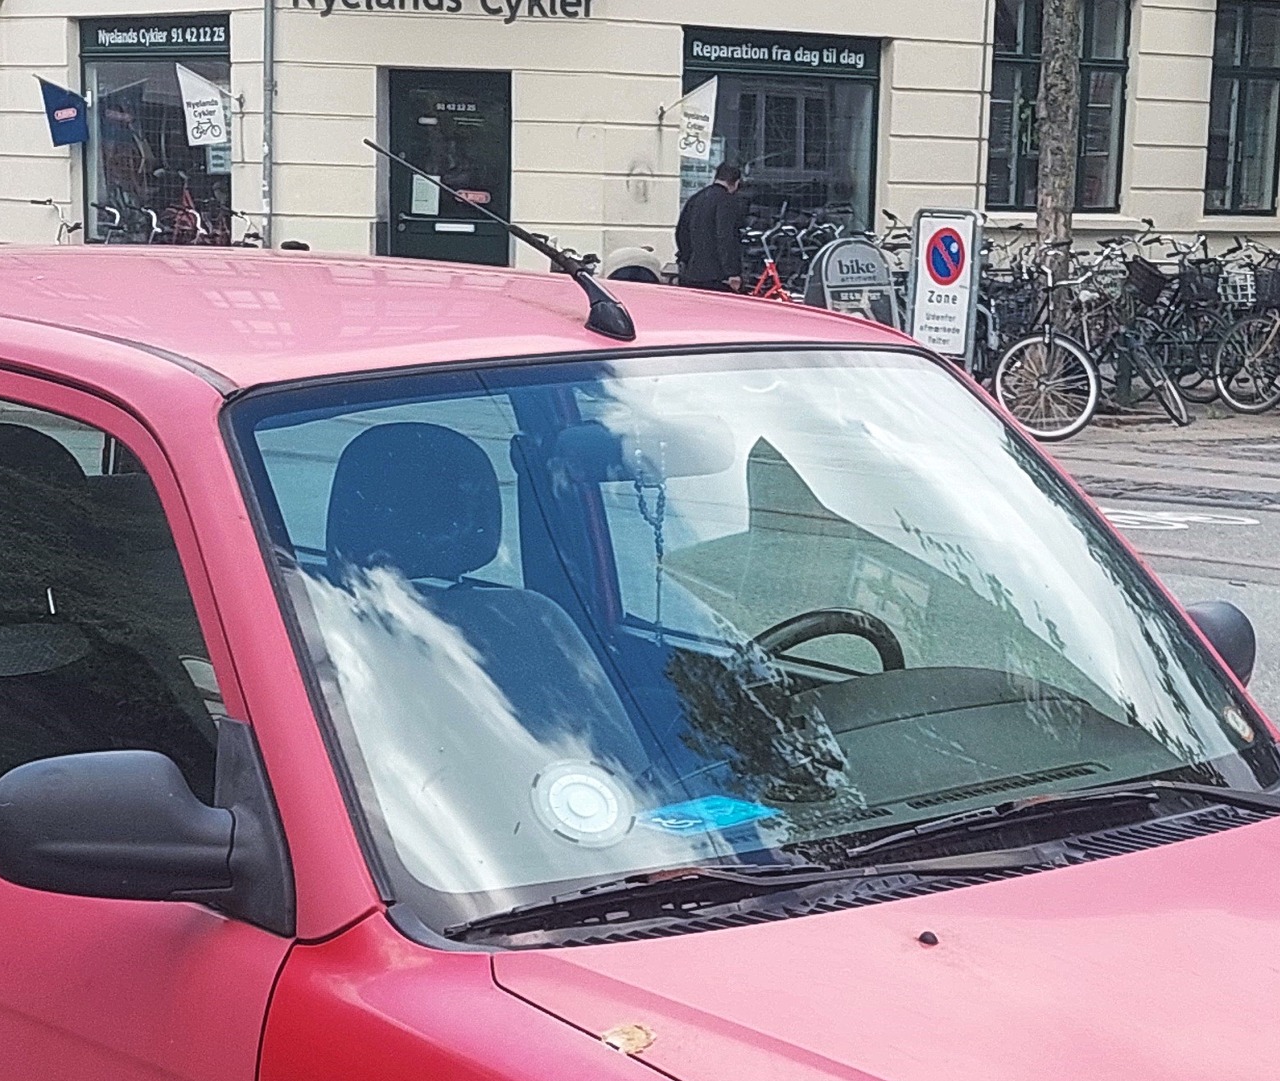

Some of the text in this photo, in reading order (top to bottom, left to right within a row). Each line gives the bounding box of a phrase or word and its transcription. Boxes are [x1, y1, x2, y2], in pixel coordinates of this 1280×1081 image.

[98, 27, 225, 47] Nyelands Cykler 91 42 12 25
[692, 41, 865, 68] Reparation fra dag til dag
[837, 258, 876, 275] bike
[927, 289, 958, 305] Zone
